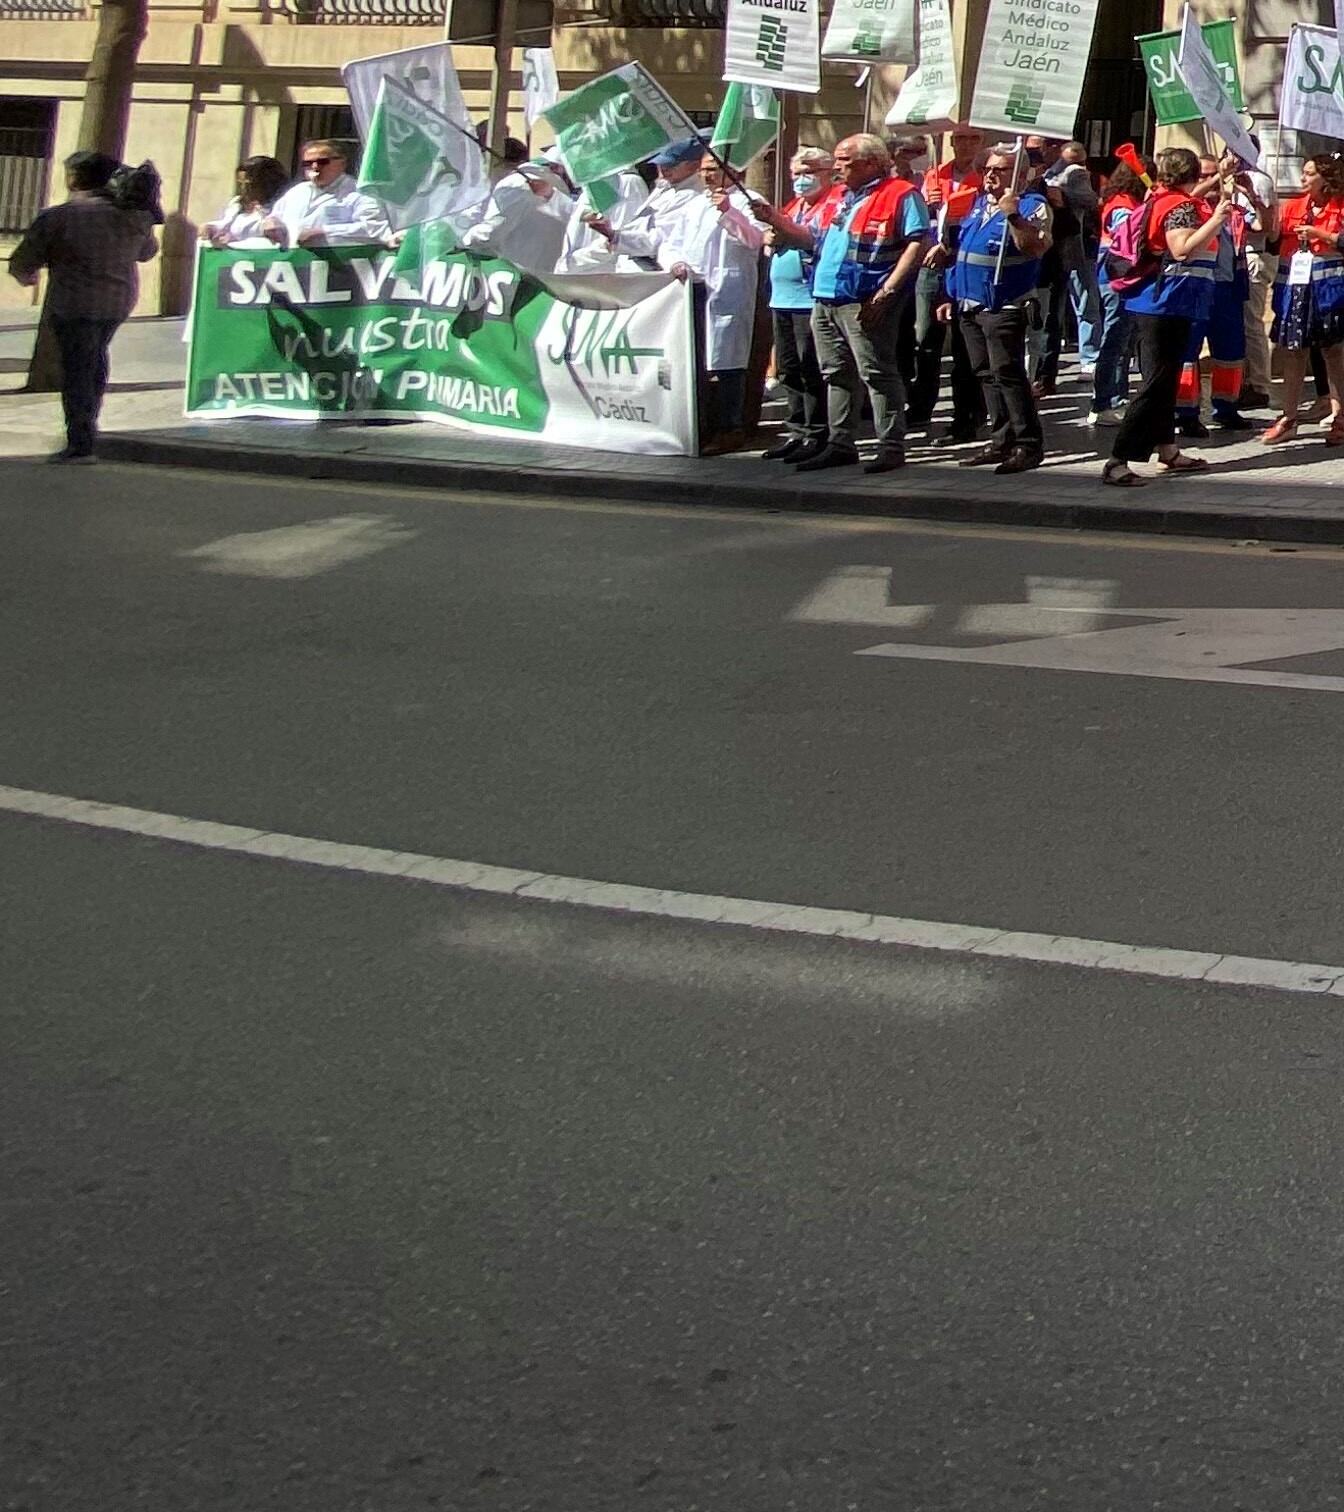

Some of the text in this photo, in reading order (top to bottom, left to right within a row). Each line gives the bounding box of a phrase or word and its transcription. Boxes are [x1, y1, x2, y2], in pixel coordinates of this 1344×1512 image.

[1008, 11, 1069, 33] Médico
[1001, 29, 1071, 51] Andaluz
[1004, 50, 1061, 74] Jaén
[595, 395, 652, 423] Cádiz
